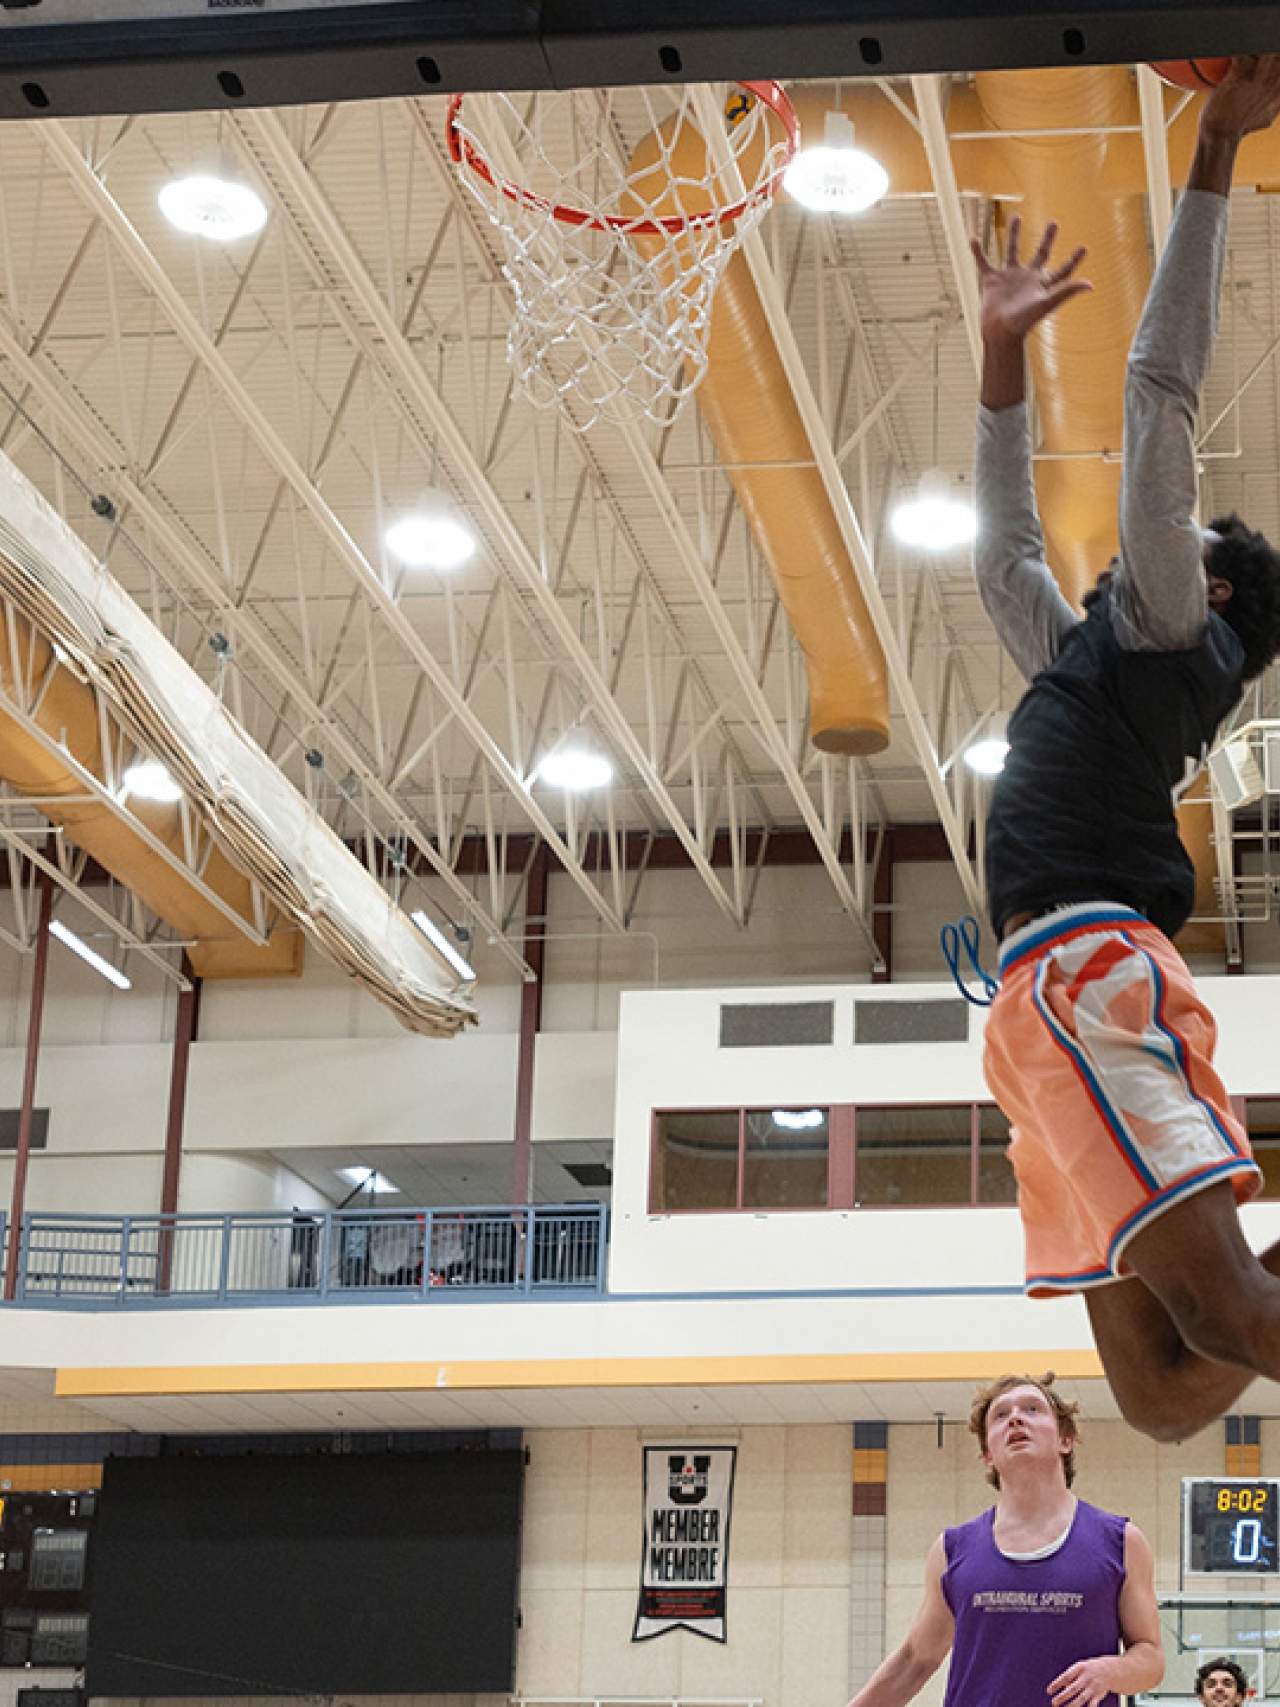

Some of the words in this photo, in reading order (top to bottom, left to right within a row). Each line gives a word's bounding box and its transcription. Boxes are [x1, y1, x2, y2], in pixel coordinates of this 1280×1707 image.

[1217, 1489, 1267, 1511] 8:02
[651, 1509, 719, 1542] MEMBER
[1233, 1519, 1261, 1563] 0
[650, 1547, 718, 1581] MEMBRE
[1040, 1591, 1083, 1607] SPORTS
